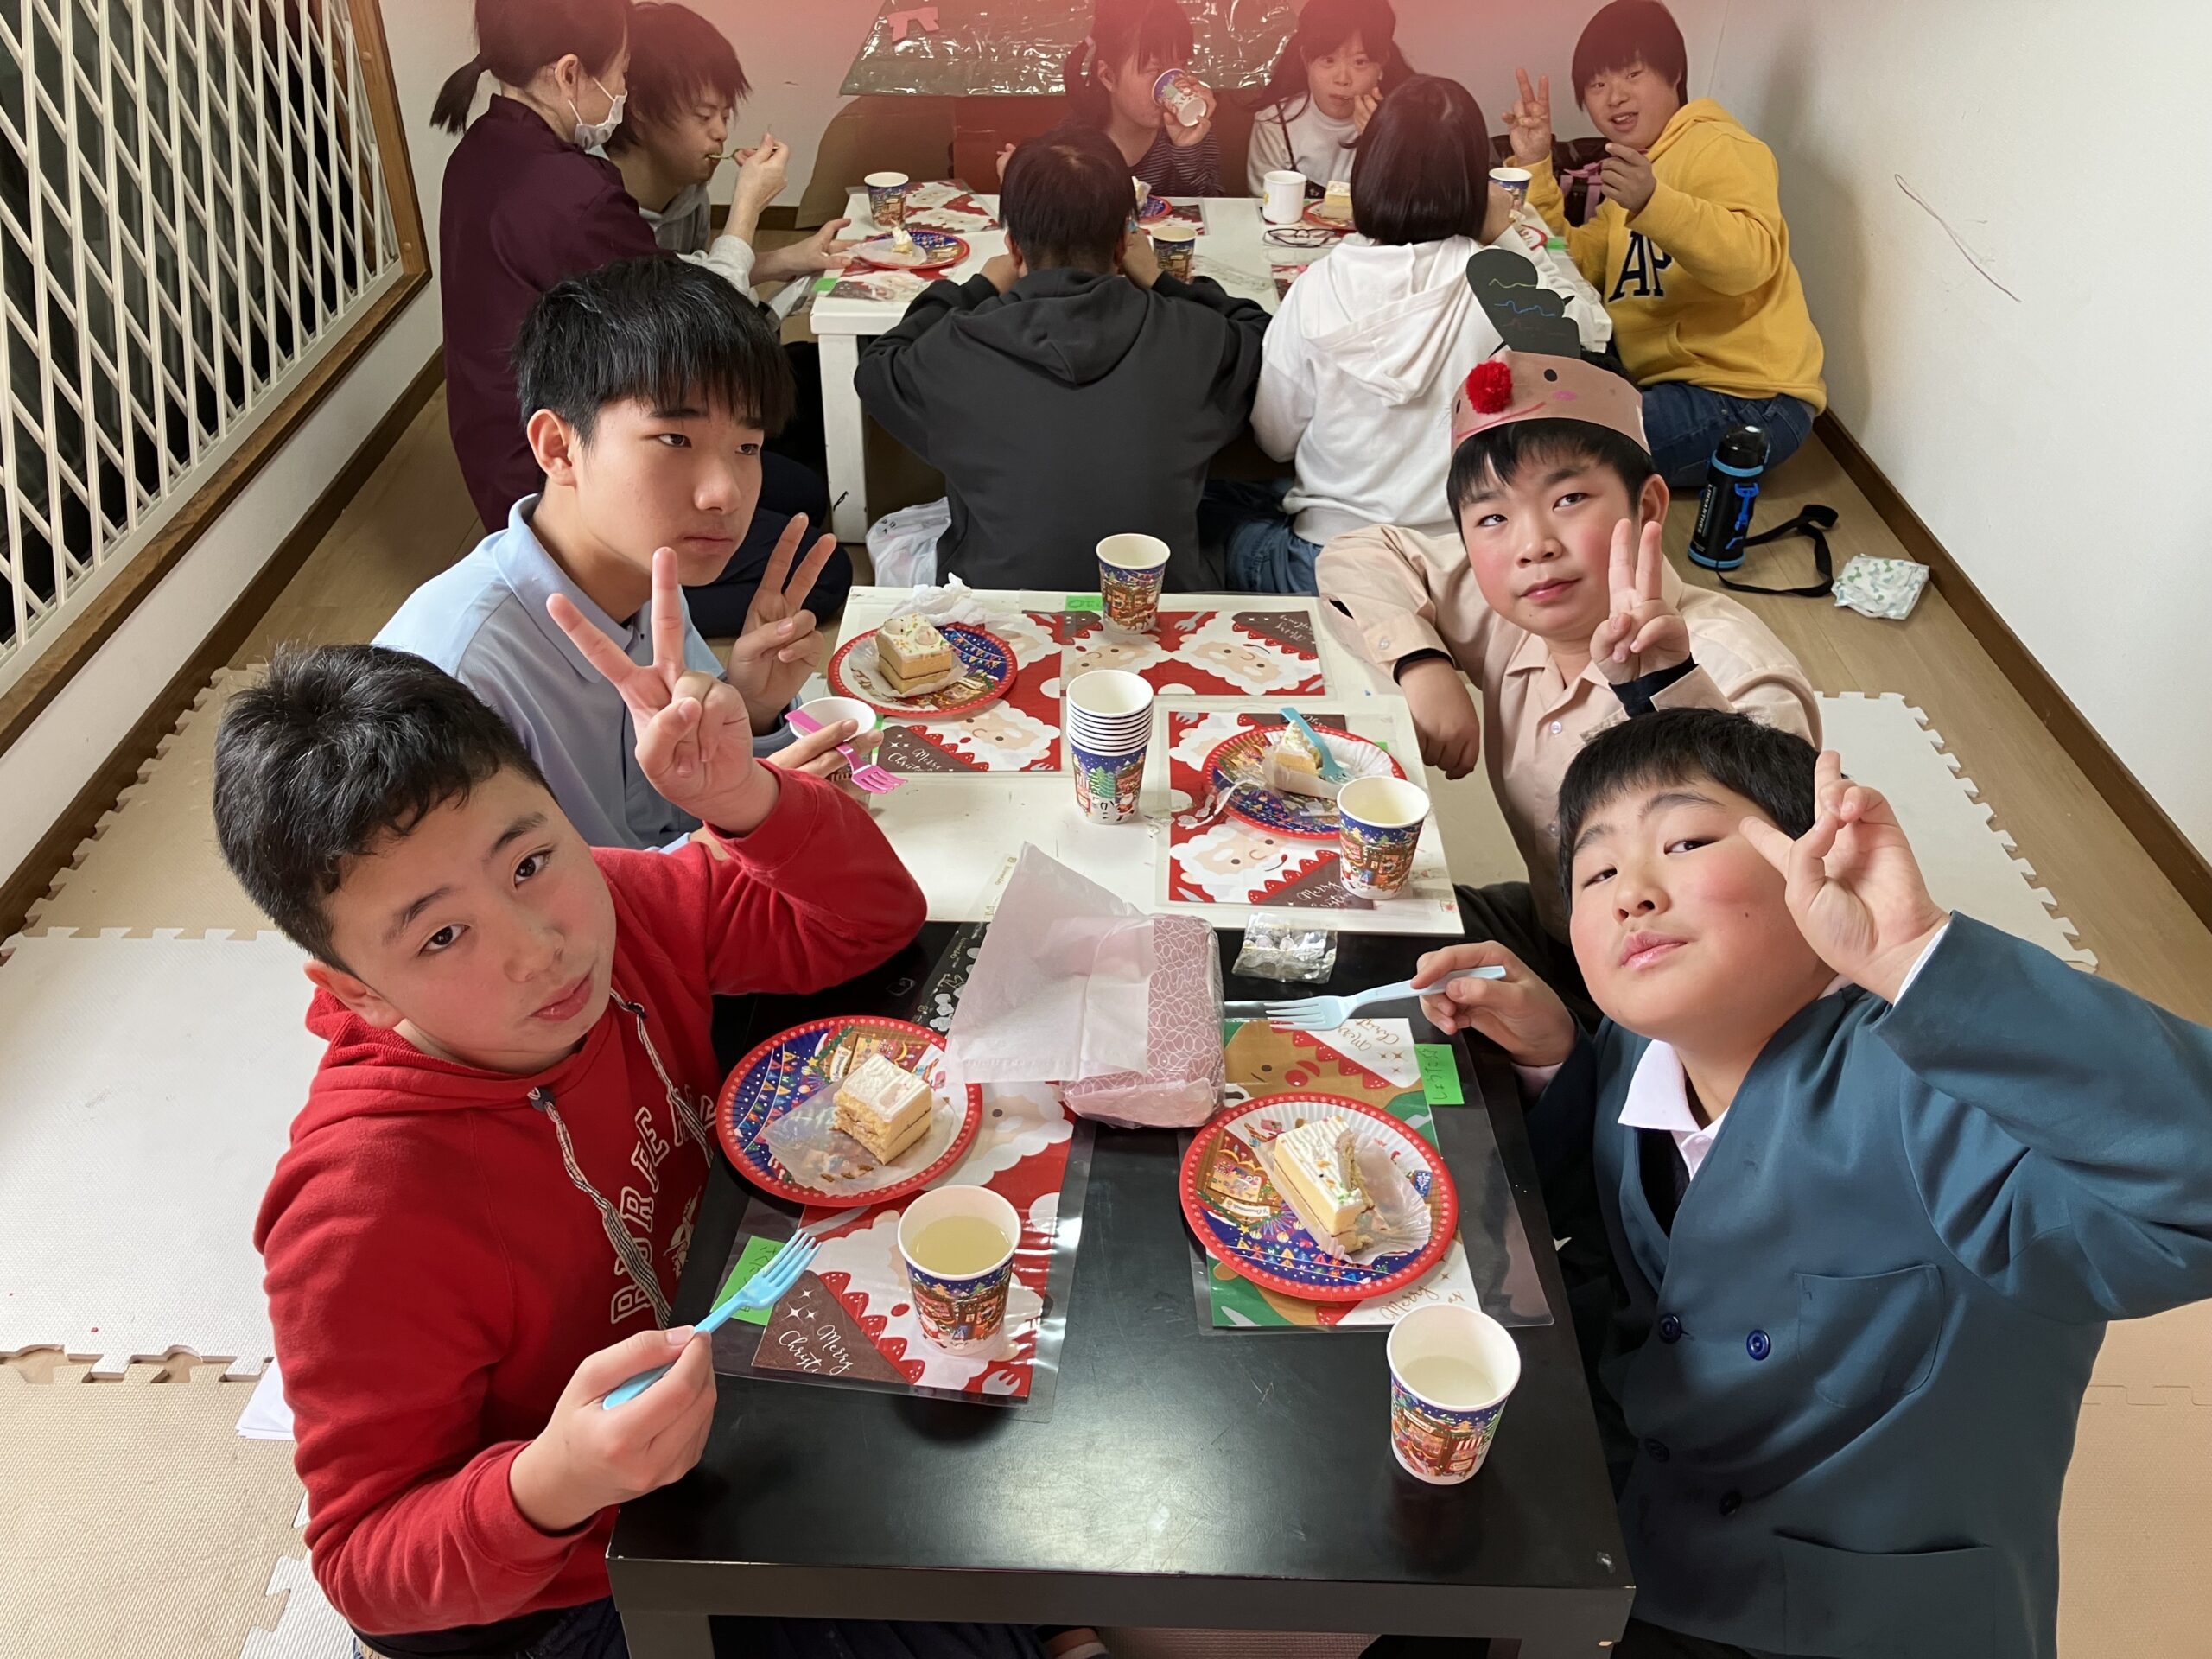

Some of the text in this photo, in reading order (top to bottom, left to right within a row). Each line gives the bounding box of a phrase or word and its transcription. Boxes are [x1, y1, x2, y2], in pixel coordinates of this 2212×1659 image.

[1338, 1027, 1372, 1052] Merr
[1380, 1285, 1440, 1320] Merry
[817, 1324, 854, 1376] Merry
